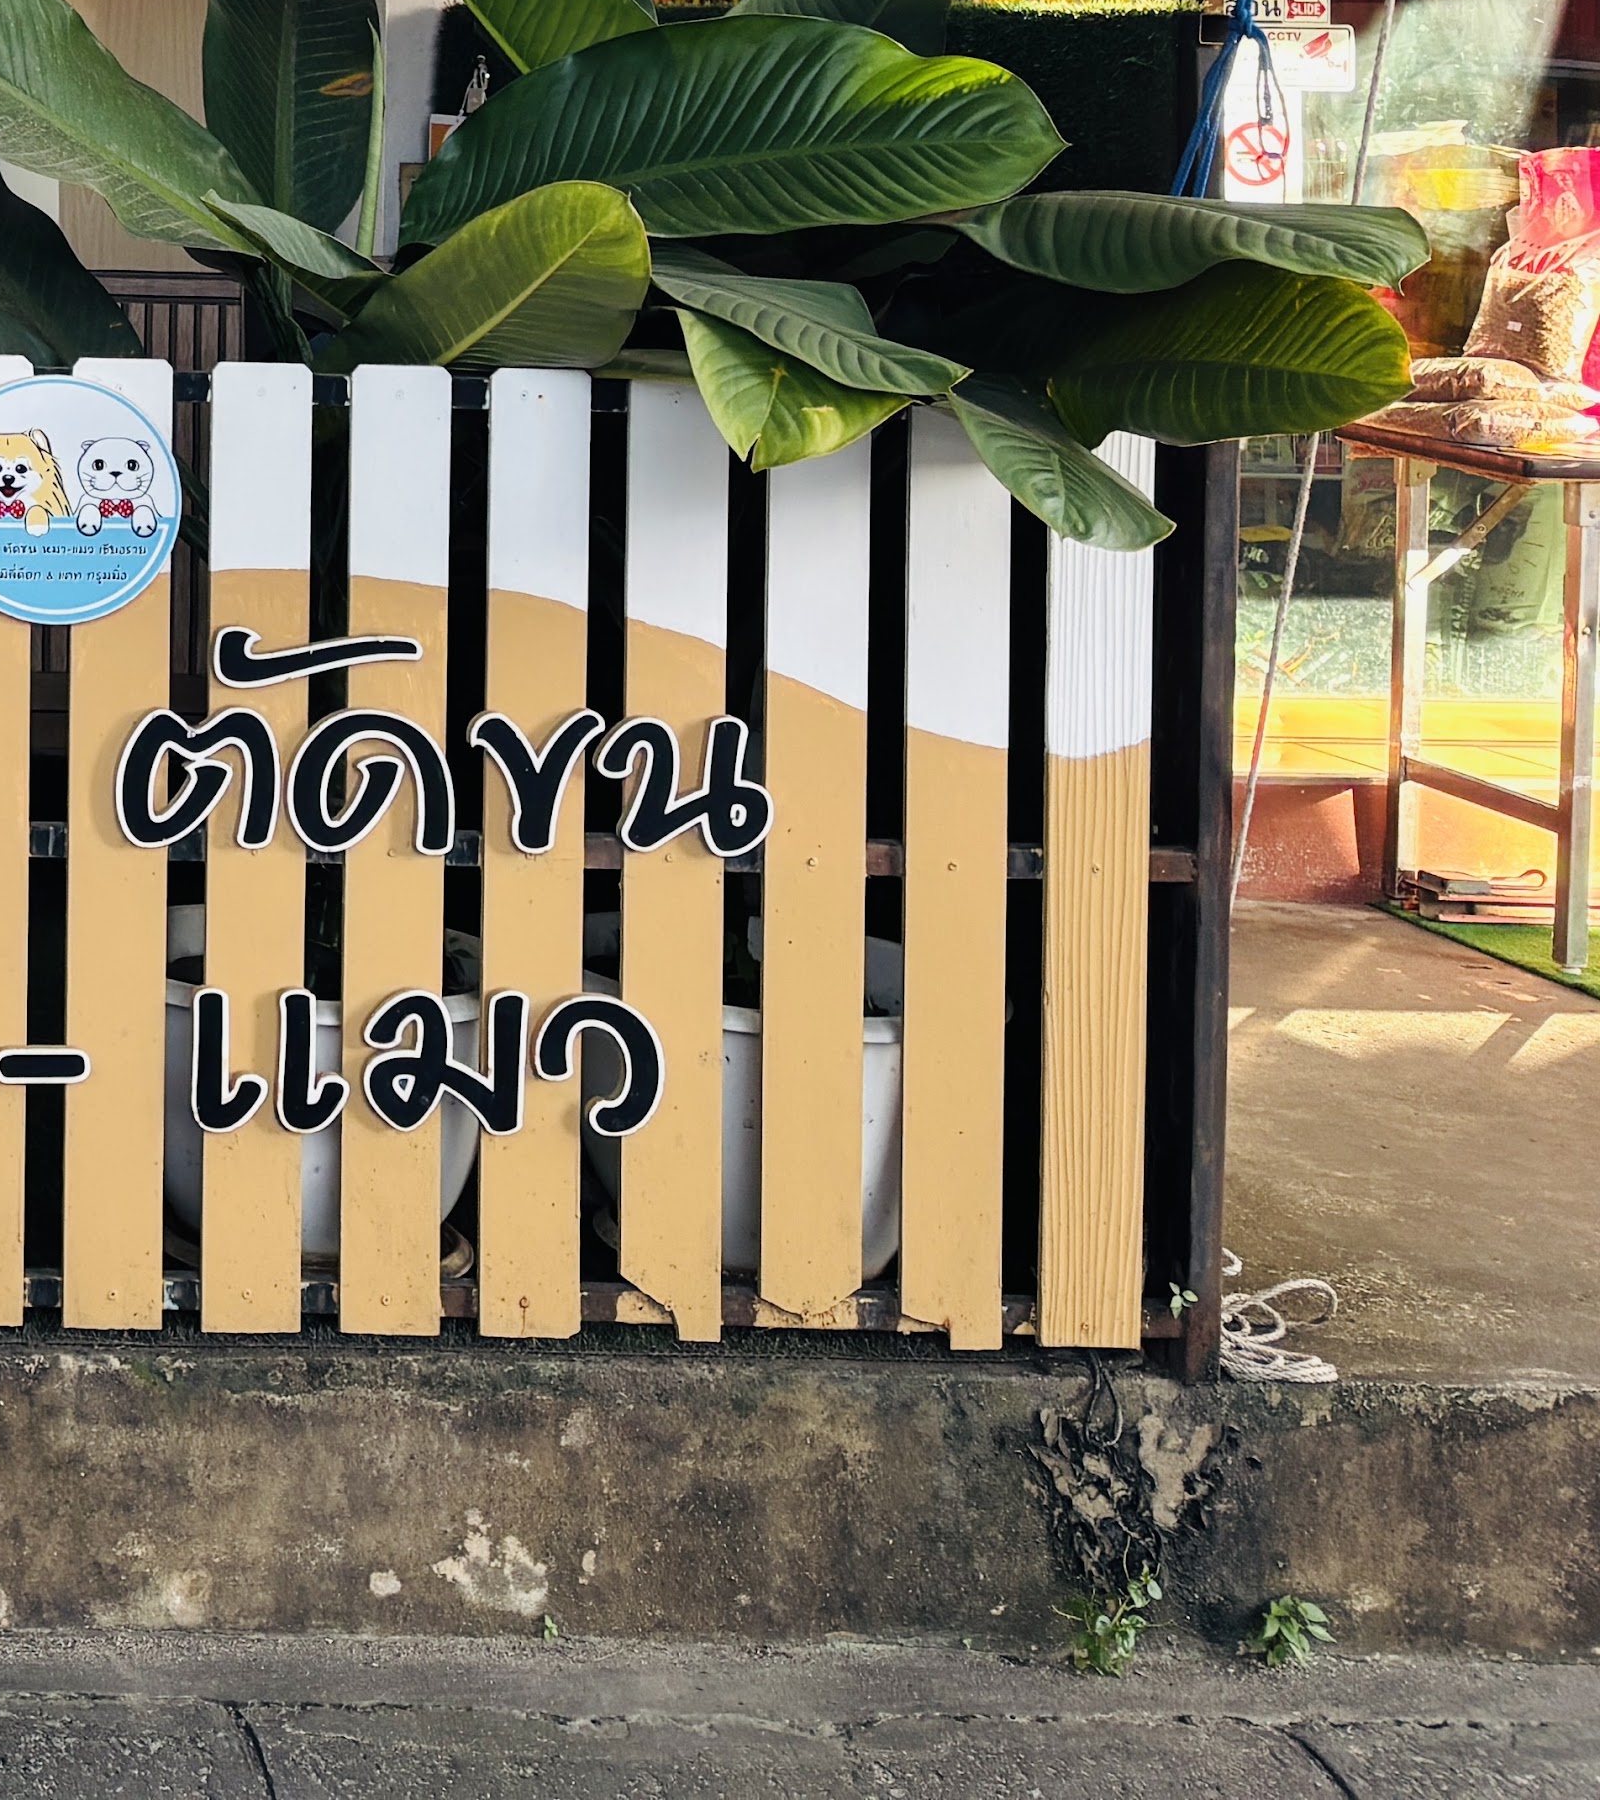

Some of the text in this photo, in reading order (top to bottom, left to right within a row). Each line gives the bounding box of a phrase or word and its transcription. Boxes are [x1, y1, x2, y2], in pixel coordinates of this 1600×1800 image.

[1267, 31, 1302, 42] CCTV
[1290, 2, 1321, 16] SLIDE
[116, 626, 773, 857] ตัดขน
[192, 988, 664, 1136] แมว
